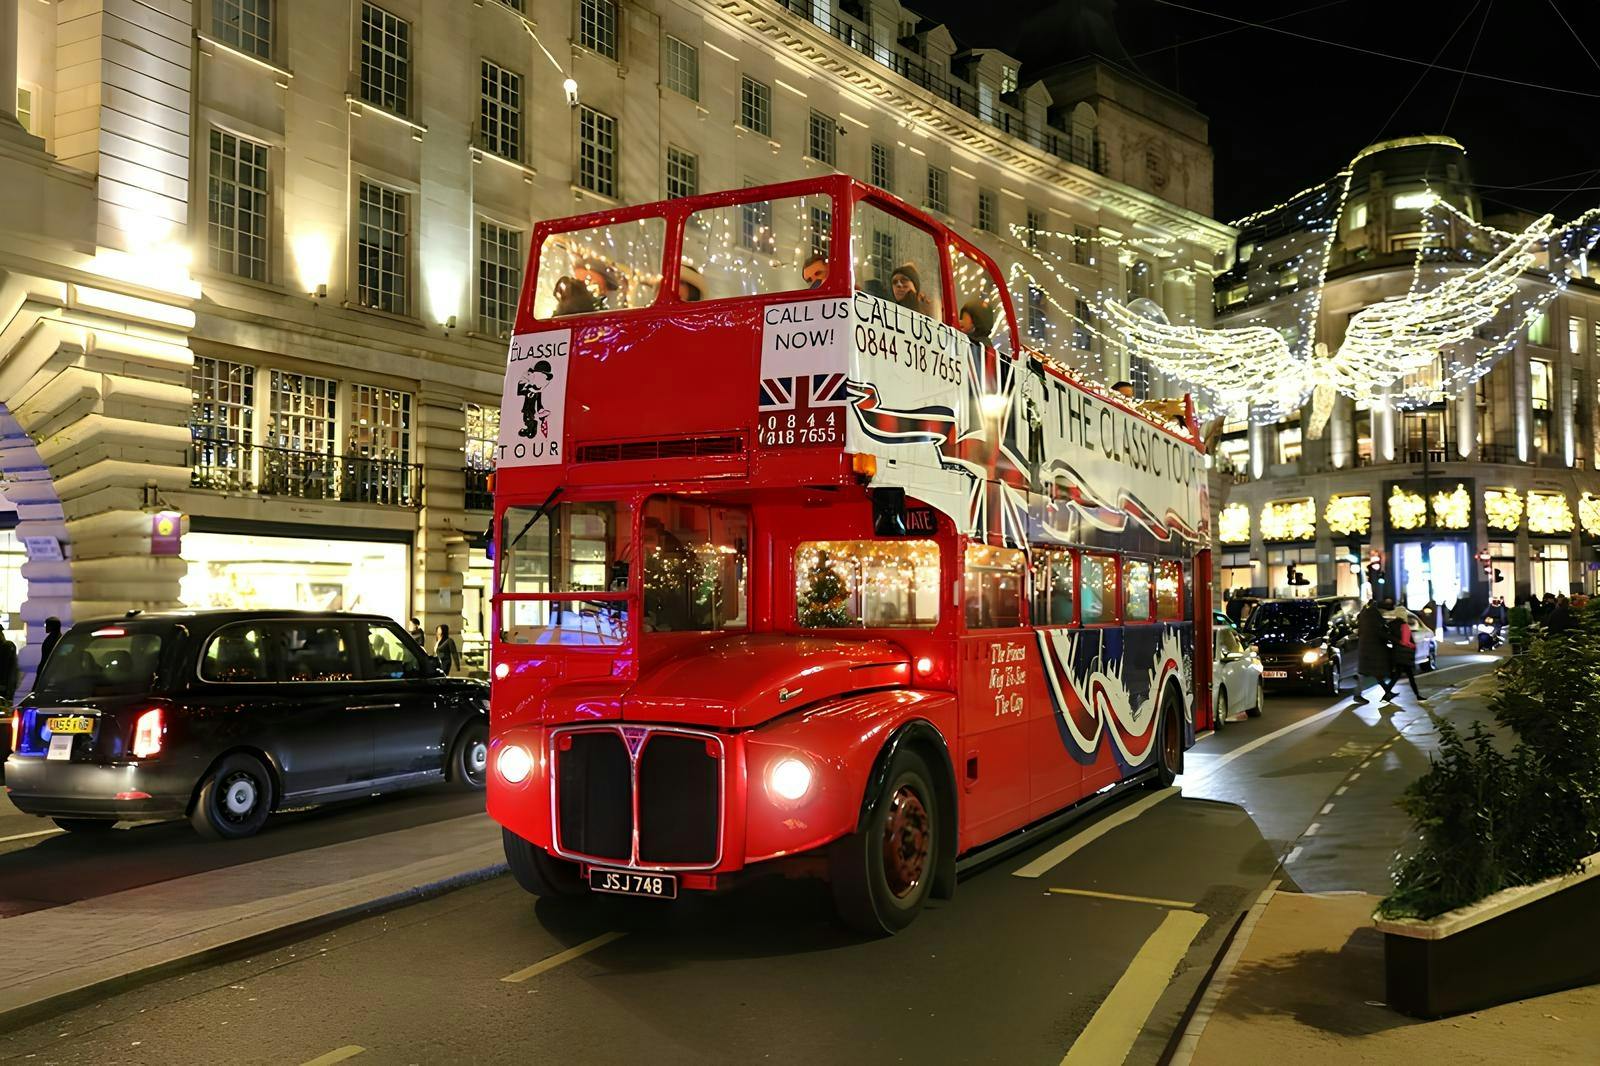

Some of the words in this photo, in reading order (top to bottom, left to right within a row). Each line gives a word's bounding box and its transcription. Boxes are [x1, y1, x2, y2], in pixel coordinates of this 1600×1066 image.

[765, 305, 814, 325] CALL
[822, 302, 849, 320] US
[854, 291, 905, 335] CALL
[911, 311, 932, 345] US
[775, 329, 834, 350] NOW!
[855, 324, 898, 362] 0844
[904, 340, 927, 373] 318
[931, 350, 961, 386] 7655
[767, 411, 835, 430] 0844
[1053, 380, 1095, 451] THE
[1100, 407, 1162, 477] CLASSIC
[799, 427, 836, 444] 7655
[498, 441, 559, 460] TOUR
[602, 873, 629, 891] JSJ
[633, 876, 663, 895] 748
